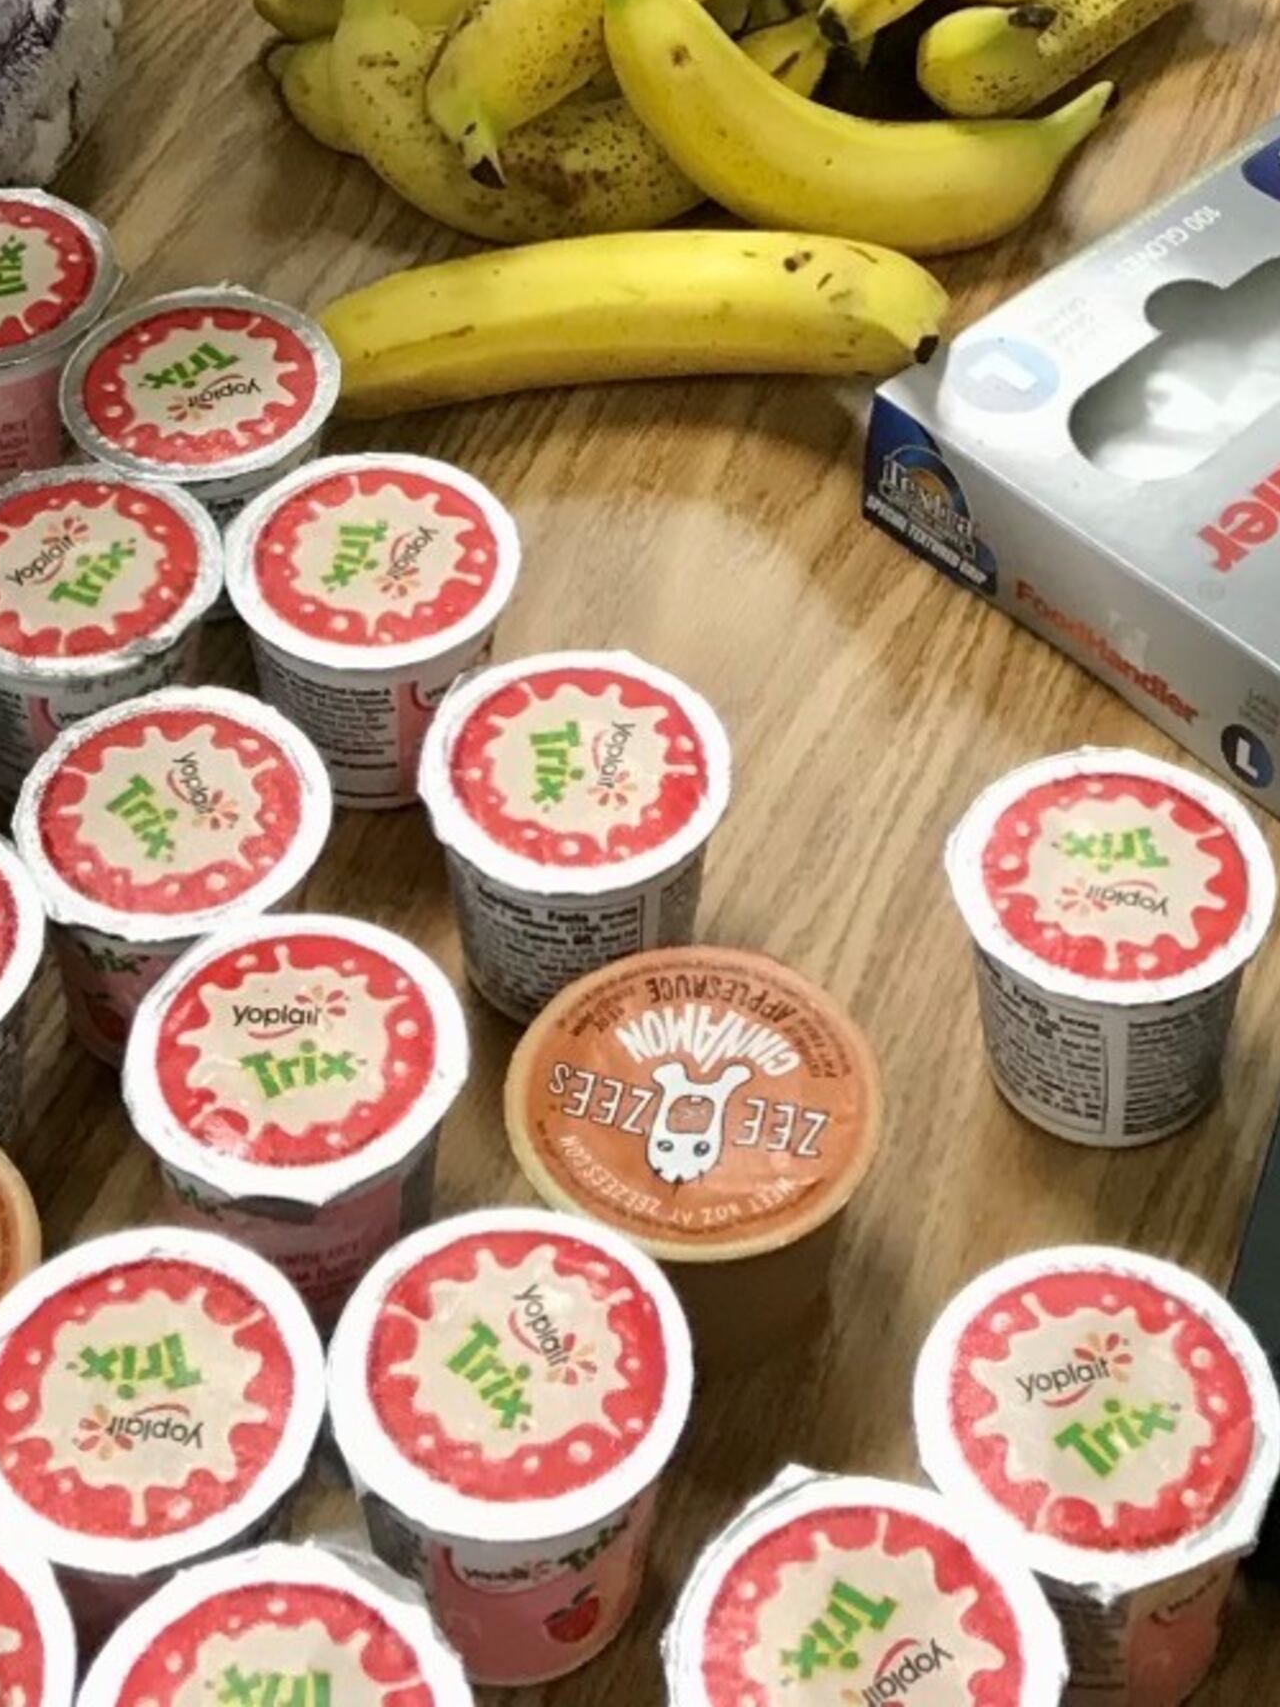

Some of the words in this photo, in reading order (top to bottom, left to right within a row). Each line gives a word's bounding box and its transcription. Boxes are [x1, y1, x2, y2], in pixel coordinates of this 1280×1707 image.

[1183, 204, 1221, 232] 100
[137, 343, 239, 393] Trix
[49, 541, 133, 606] Trix
[323, 524, 387, 588] Trix
[1015, 579, 1199, 725] FoodHandler
[530, 722, 581, 803] Trix
[1234, 735, 1260, 780] L
[108, 775, 174, 857] Trix
[1061, 828, 1170, 871] Trix
[643, 973, 800, 1024] APPLESAUCE
[241, 1043, 354, 1096] Trix
[614, 1002, 802, 1079] CINNAMON
[547, 1060, 657, 1136] ZEES
[731, 1096, 831, 1160] ZEE
[75, 1334, 196, 1398] Trix
[445, 1322, 528, 1429] Trix
[1054, 1399, 1172, 1476] Trix
[786, 1581, 895, 1677] Trix
